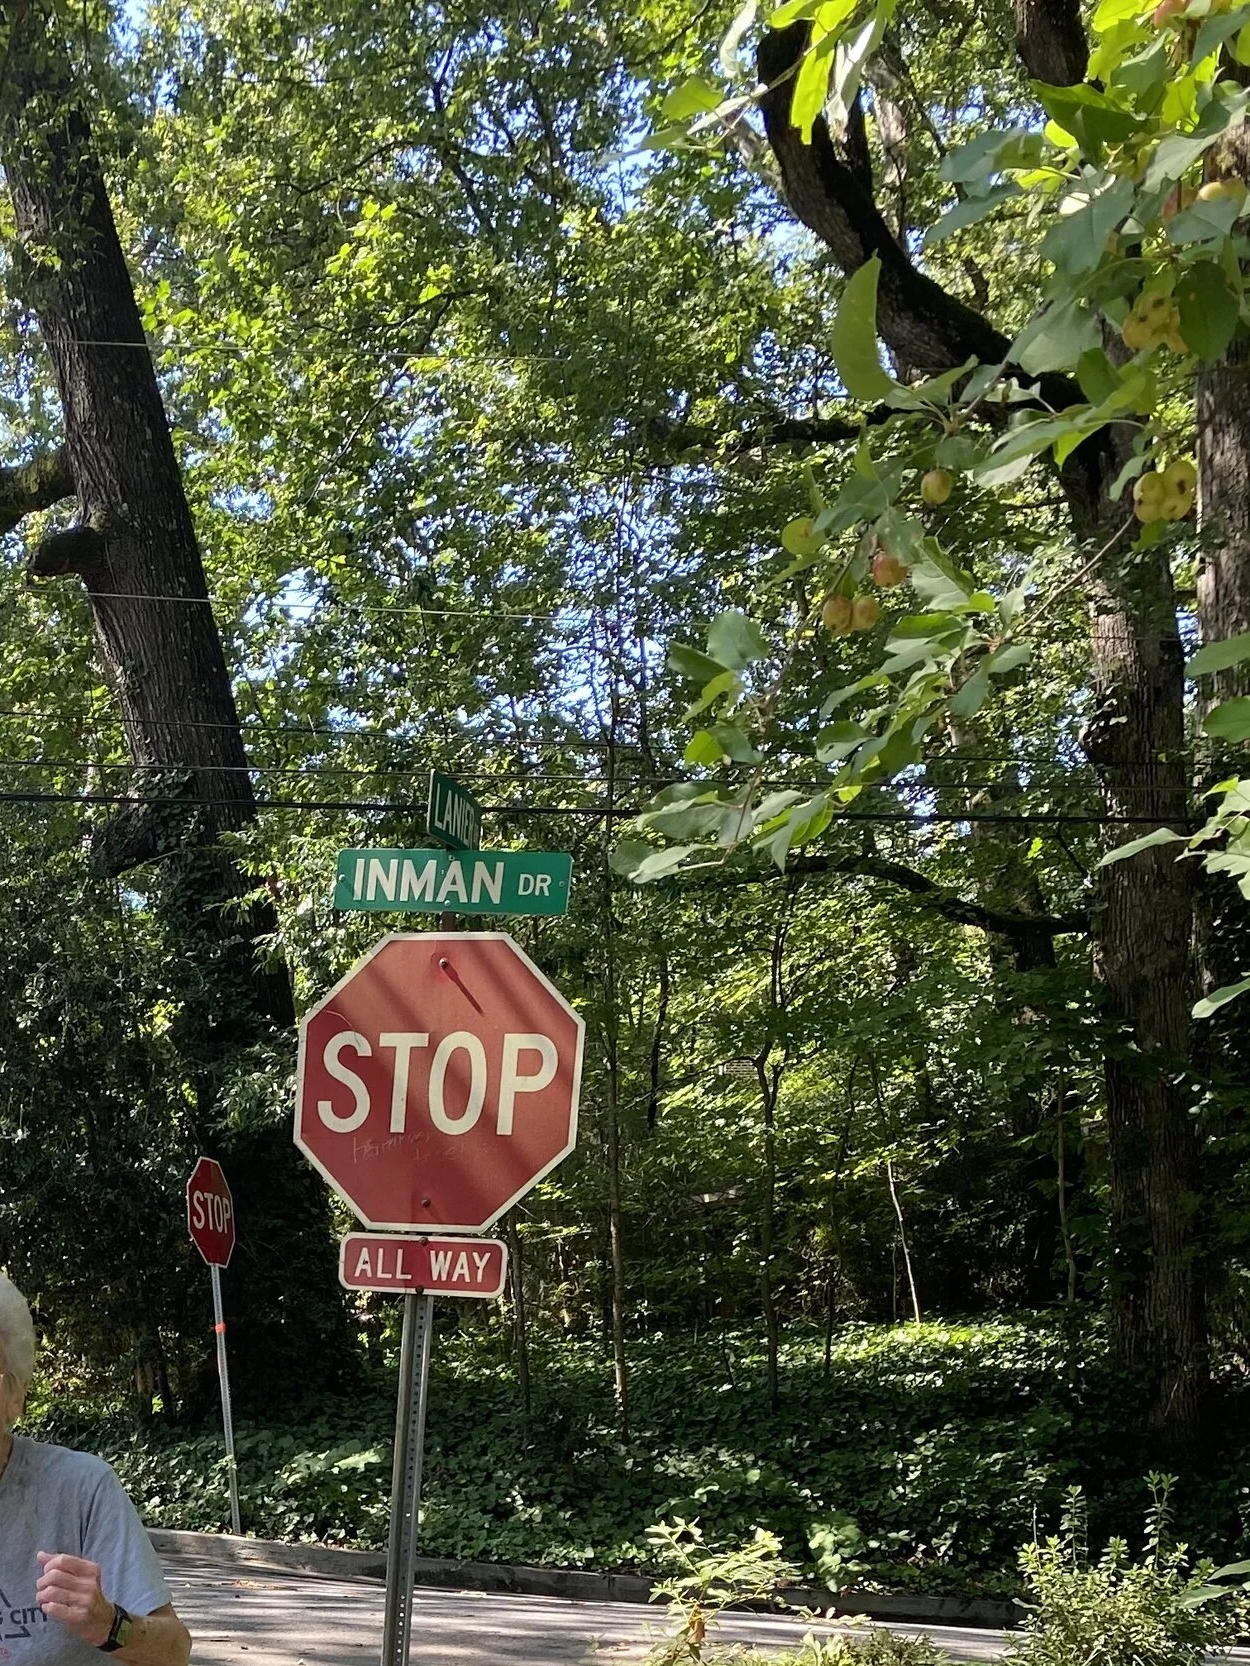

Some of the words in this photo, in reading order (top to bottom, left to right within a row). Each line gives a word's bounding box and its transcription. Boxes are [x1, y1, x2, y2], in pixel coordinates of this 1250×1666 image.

[434, 782, 474, 849] LANIER
[352, 858, 504, 904] INMAN
[517, 873, 552, 897] DR
[317, 1031, 558, 1136] STOP
[193, 1190, 230, 1234] STOP
[354, 1247, 412, 1280] ALL
[429, 1250, 491, 1283] WAY
